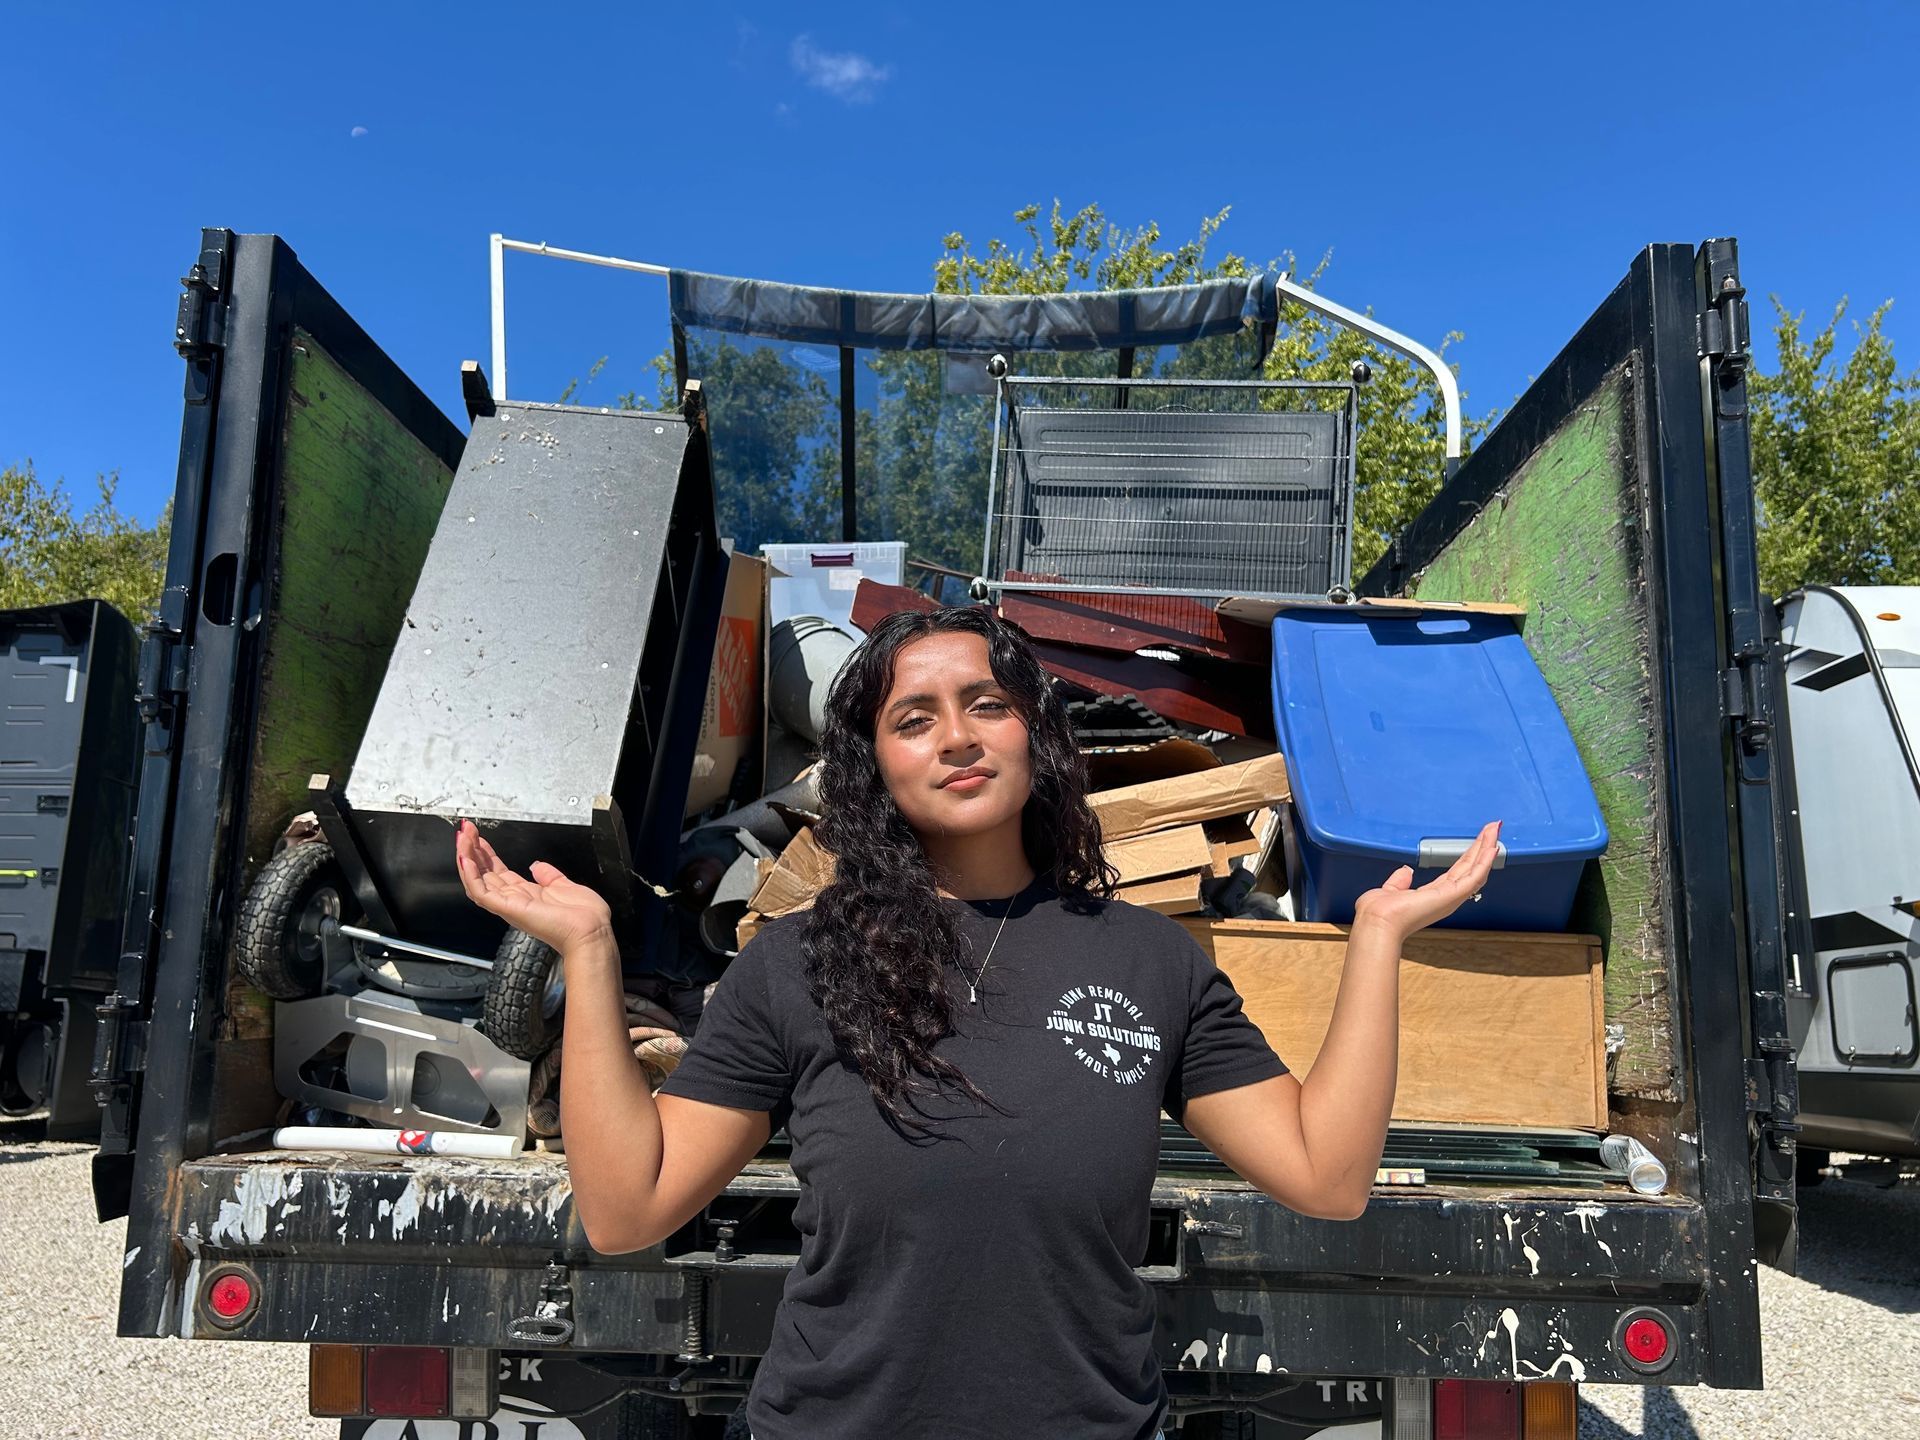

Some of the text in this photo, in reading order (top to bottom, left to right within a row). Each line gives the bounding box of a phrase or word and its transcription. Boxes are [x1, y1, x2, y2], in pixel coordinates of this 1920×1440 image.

[1059, 985, 1144, 1022] JUNK REMOVAL
[1093, 1002, 1113, 1023] JT
[1046, 1016, 1161, 1052] JUNK SOLUTIONS
[1074, 1047, 1146, 1085] MADE SIMPLE
